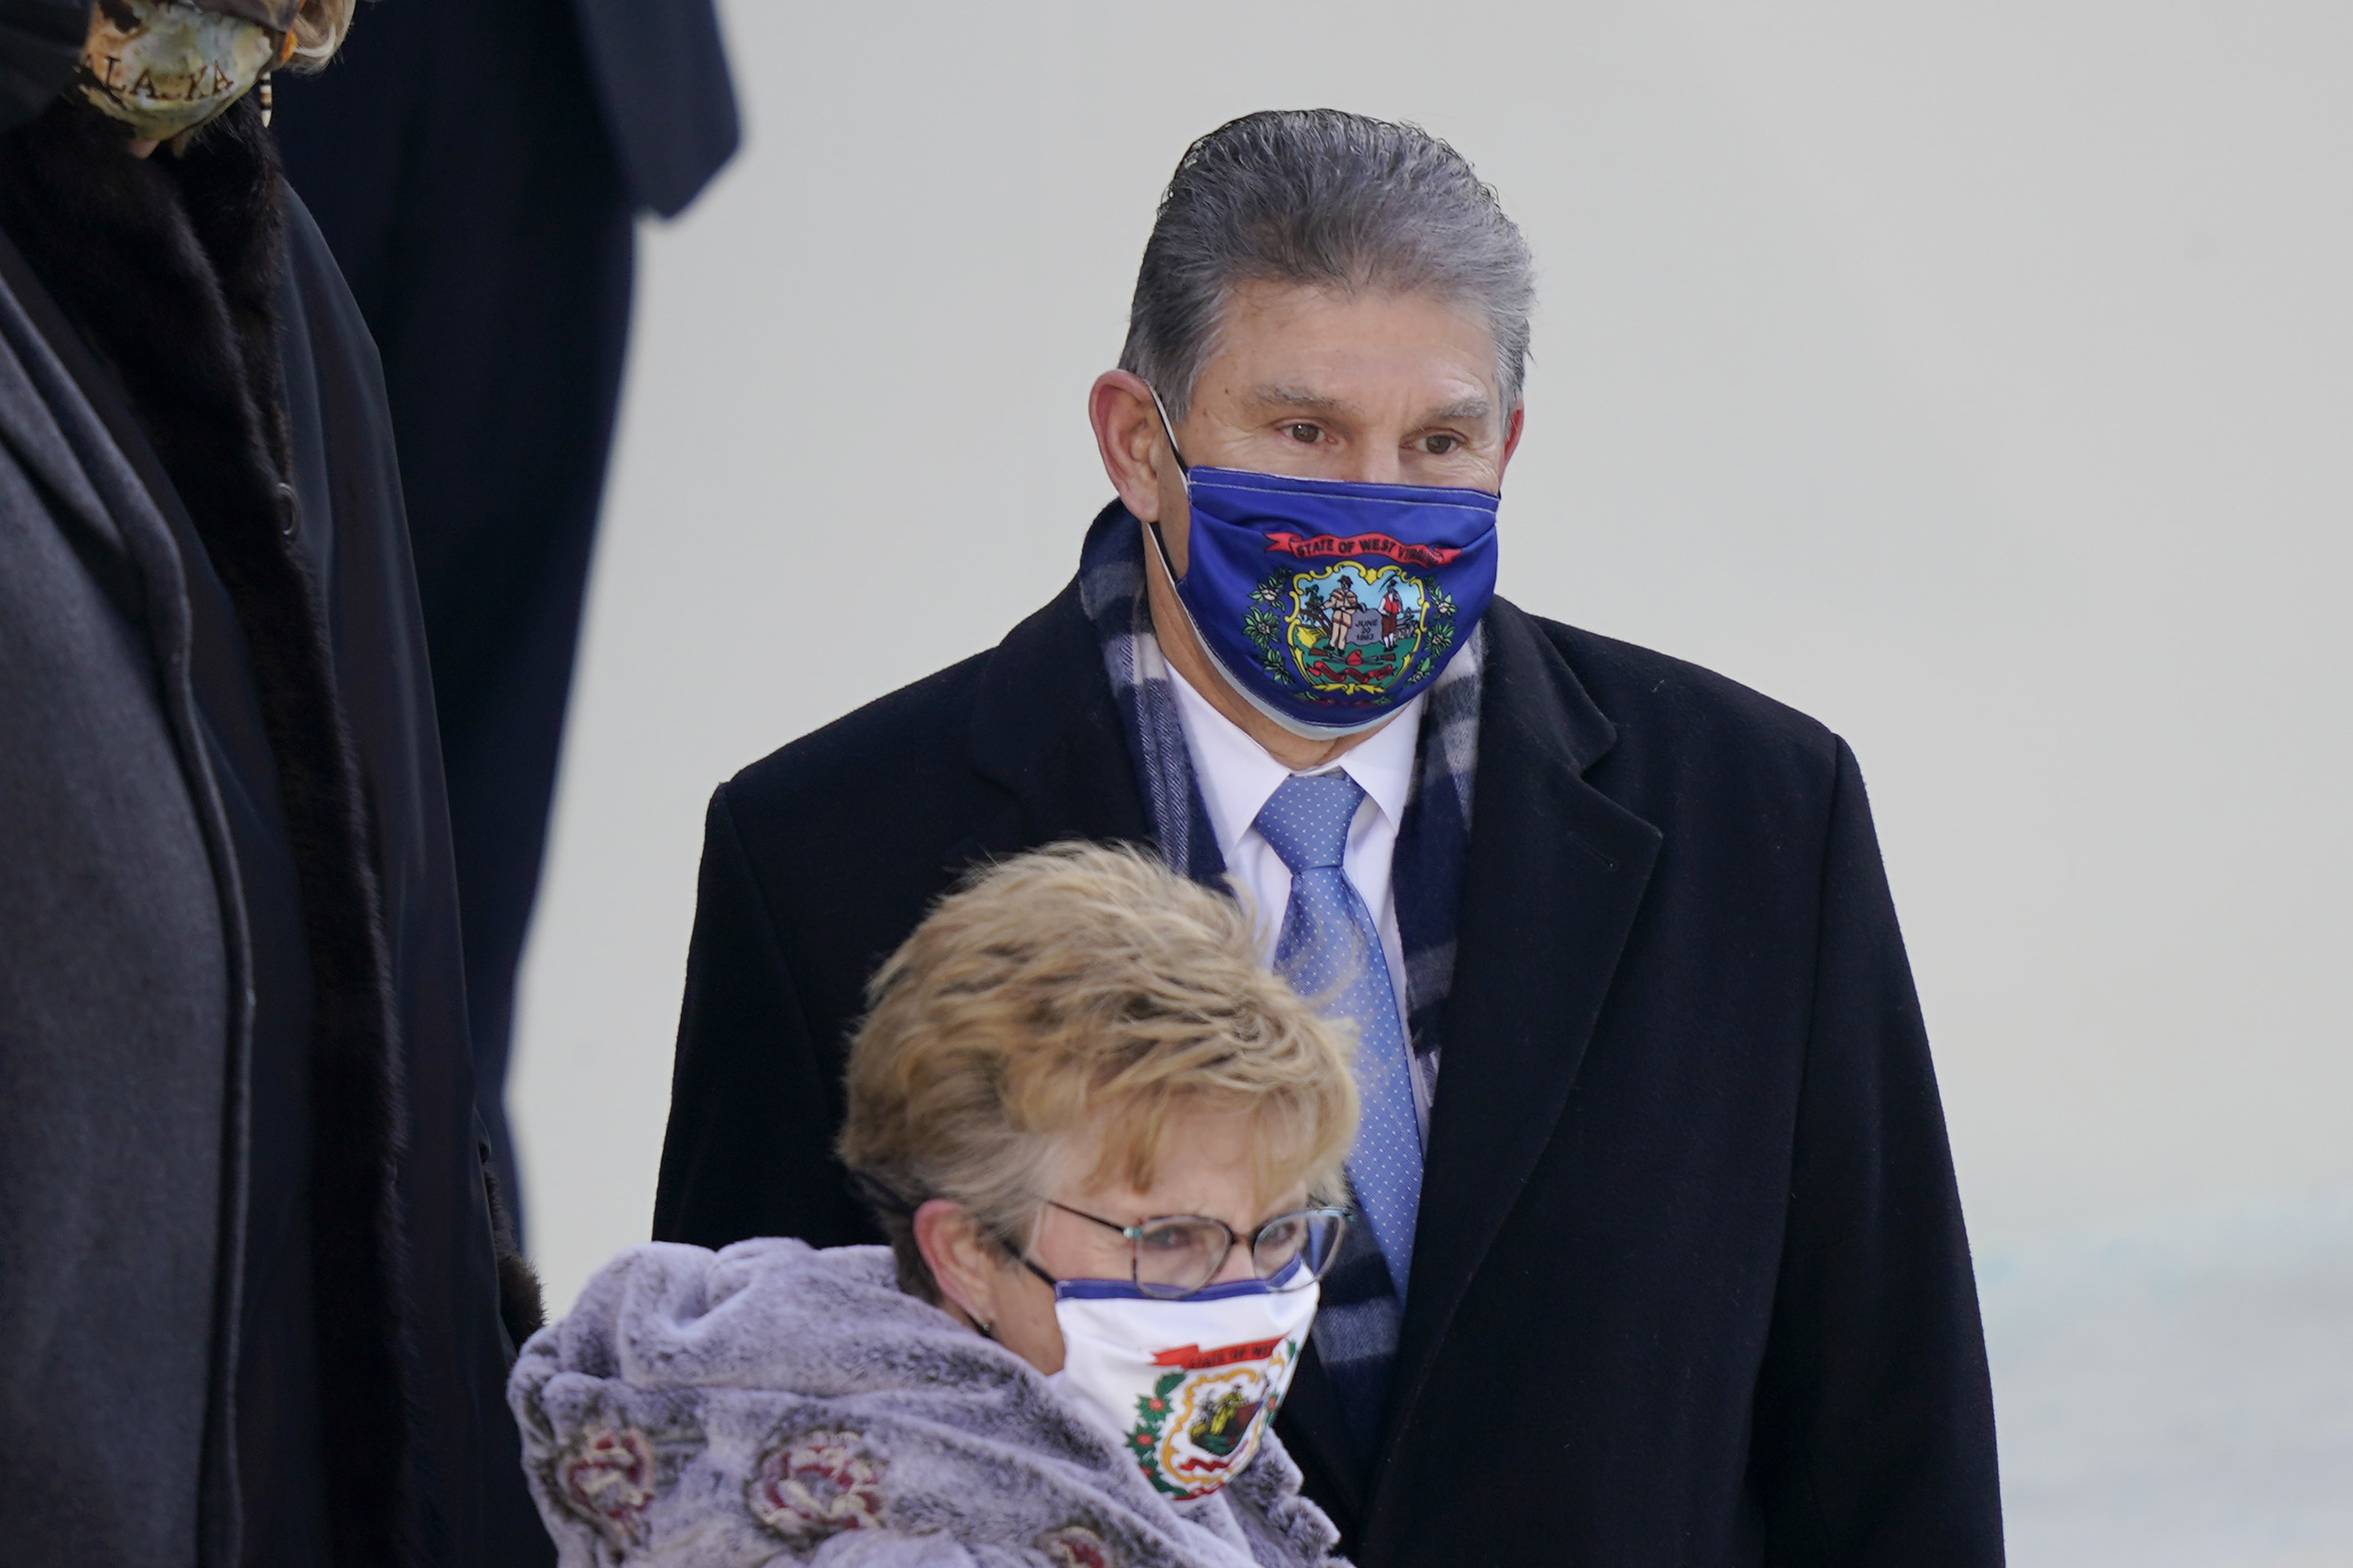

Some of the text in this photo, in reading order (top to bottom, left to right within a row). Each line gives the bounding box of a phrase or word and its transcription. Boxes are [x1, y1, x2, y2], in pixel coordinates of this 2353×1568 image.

[1297, 539, 1333, 557] STATE
[1338, 540, 1355, 554] OF
[1359, 538, 1396, 553] WEST
